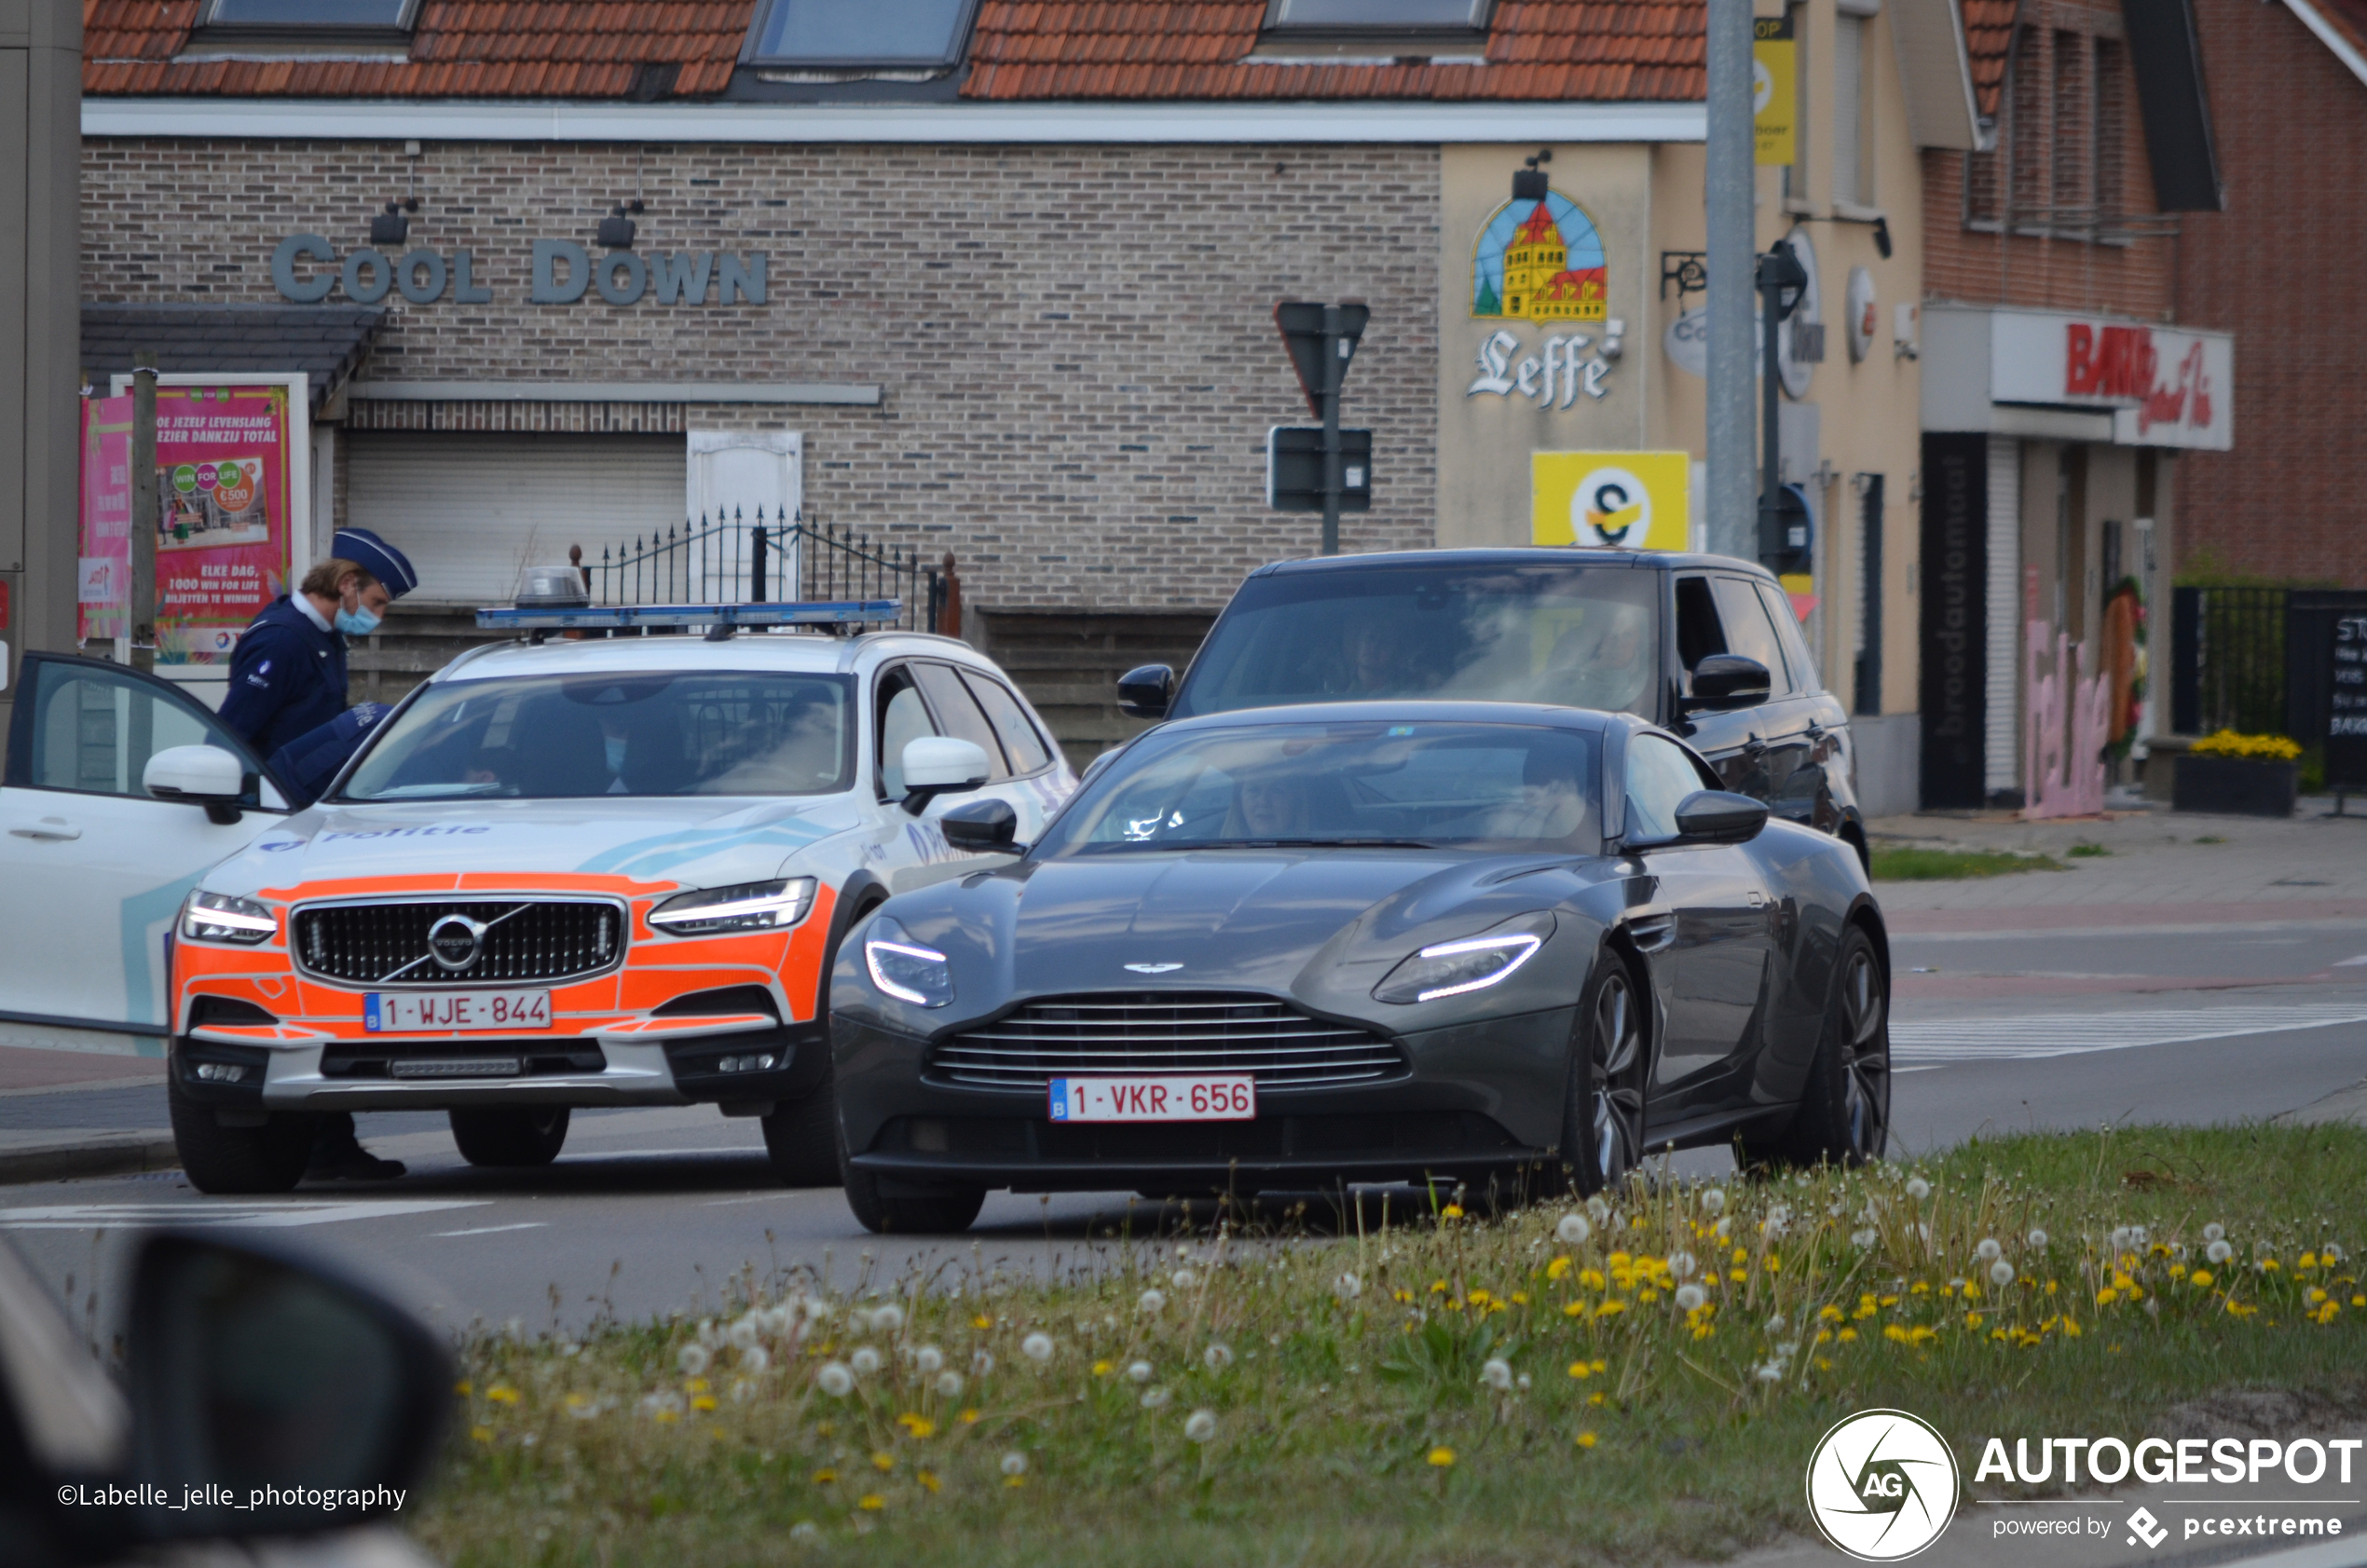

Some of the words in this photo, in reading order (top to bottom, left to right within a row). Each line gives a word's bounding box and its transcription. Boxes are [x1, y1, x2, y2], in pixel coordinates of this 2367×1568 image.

[1755, 20, 1782, 38] OP
[1465, 329, 1611, 410] Leffe
[157, 417, 170, 428] OE
[172, 417, 206, 428] JEZELF
[209, 417, 272, 428] LEVENSLANG
[157, 430, 188, 443] EZIER
[191, 430, 239, 443] DANKZIJ
[242, 429, 278, 443] TOTAL
[175, 473, 195, 484] WIN
[198, 471, 216, 482] FOR
[219, 470, 239, 480] LIFE
[201, 565, 227, 578] ELKE
[231, 565, 260, 579] DAG,
[169, 579, 198, 591] 1000
[200, 580, 219, 591] WIN
[221, 580, 239, 591] FOR
[241, 579, 260, 591] LIFE
[165, 594, 209, 605] BILJETTEN
[211, 593, 222, 604] TE
[223, 593, 260, 604] WINNEN
[322, 825, 491, 843] Politie
[434, 938, 472, 947] VOLVO
[1053, 1102, 1065, 1117] B
